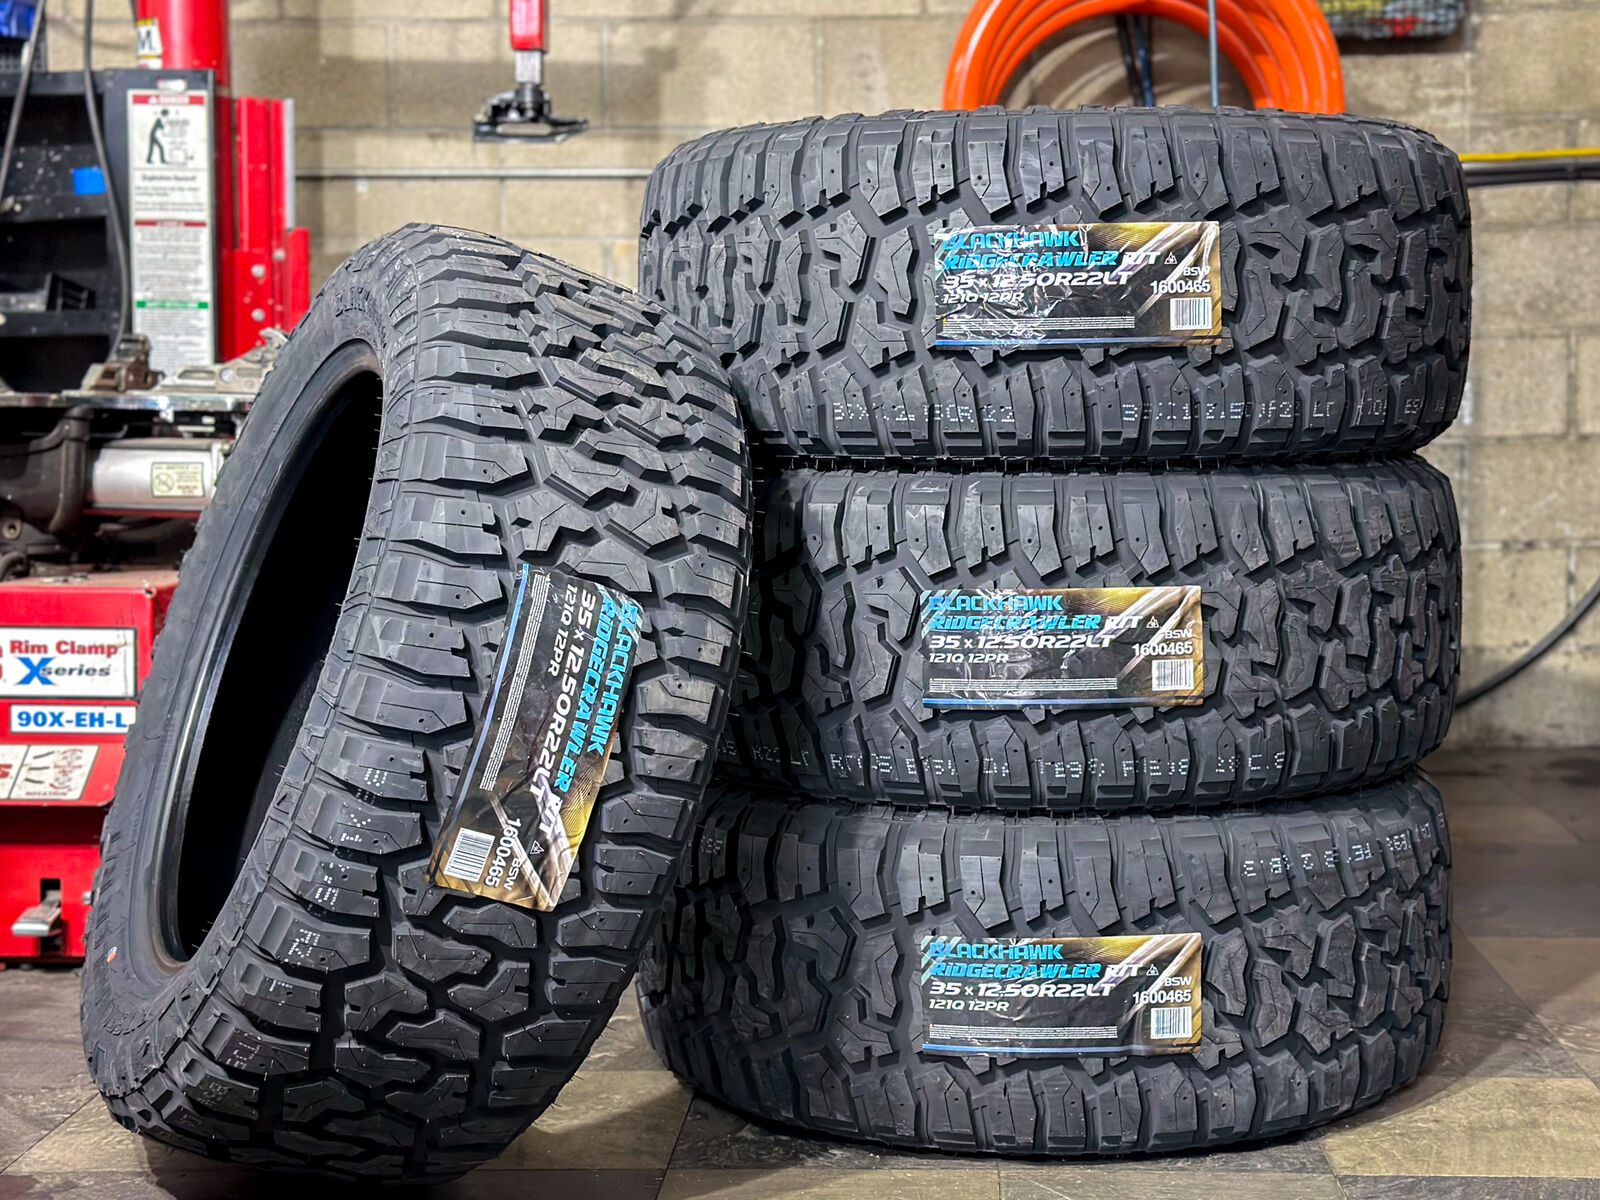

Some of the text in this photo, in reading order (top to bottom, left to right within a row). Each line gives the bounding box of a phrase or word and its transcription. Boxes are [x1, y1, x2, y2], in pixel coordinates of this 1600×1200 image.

[944, 230, 1080, 250] BLACKHAWK
[942, 274, 975, 290] 35
[1150, 279, 1211, 294] 1600465
[577, 589, 597, 629] 35
[928, 595, 1063, 611] BLACKHAWK
[548, 584, 578, 677] 121Q 12PR
[929, 614, 1101, 631] RIDGECRAWLER
[928, 635, 962, 649] 35
[1164, 629, 1192, 639] BSW
[9, 640, 48, 654] Rim
[55, 640, 118, 659] Clamp
[1132, 641, 1193, 656] 1600465
[928, 652, 1010, 663] 121Q 12PR
[587, 601, 640, 757] BLACKHAWK
[553, 595, 616, 794] RIDGECRAWLER
[17, 711, 128, 728] 90X-EH-L
[529, 643, 586, 803] 12.50R22LT
[485, 818, 522, 888] 1600465
[504, 857, 523, 891] BSW
[929, 943, 1064, 960] BLACKHAWK
[930, 962, 1101, 979] RIDGECRAWLER
[929, 981, 962, 995] 35
[978, 983, 1116, 997] 12.50R22LT
[1164, 976, 1192, 987] BSW
[928, 998, 1010, 1011] 121Q 12PR
[1132, 990, 1192, 1004] 1600465
